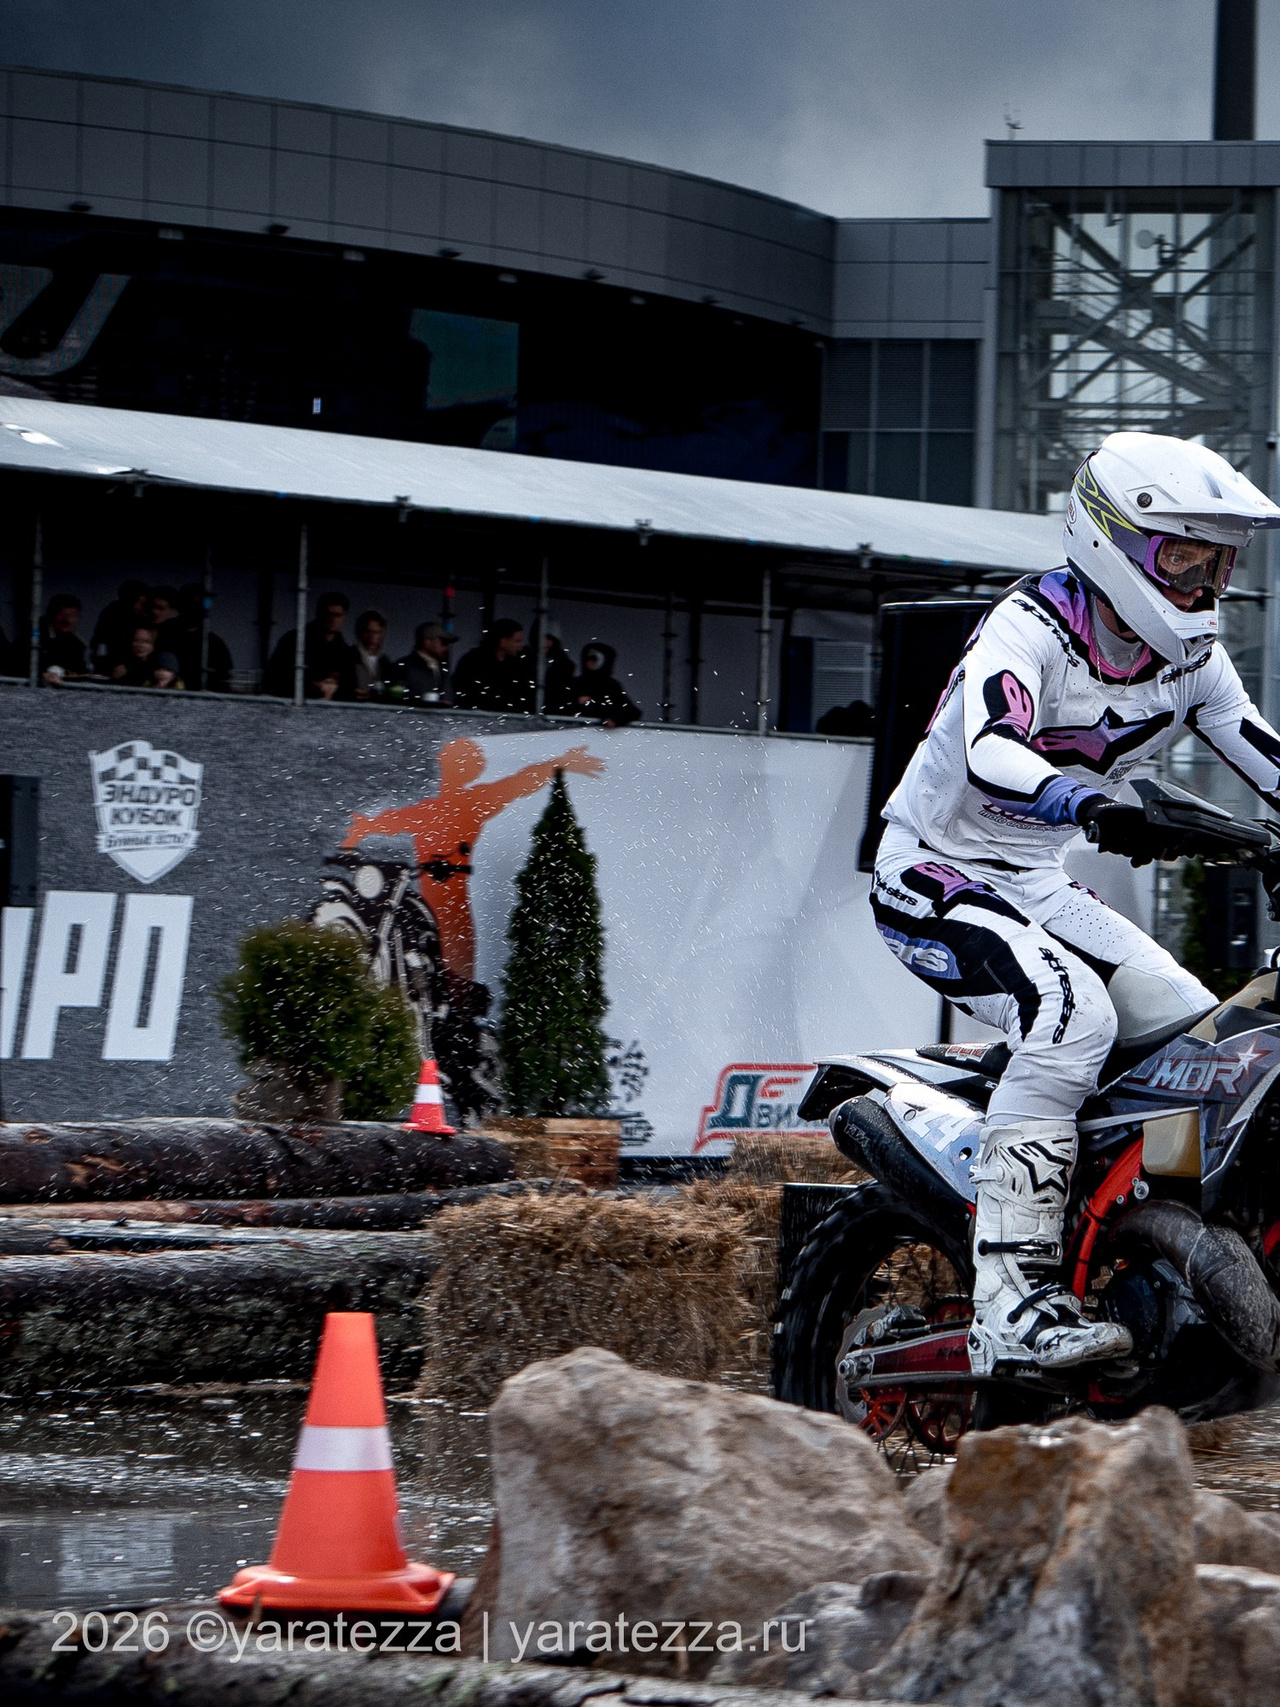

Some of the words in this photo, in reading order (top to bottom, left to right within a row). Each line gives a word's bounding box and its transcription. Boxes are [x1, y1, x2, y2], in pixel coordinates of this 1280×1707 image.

[103, 784, 197, 807] ЭНДУРО
[110, 806, 182, 826] КУБОК
[1147, 1058, 1245, 1095] MDR
